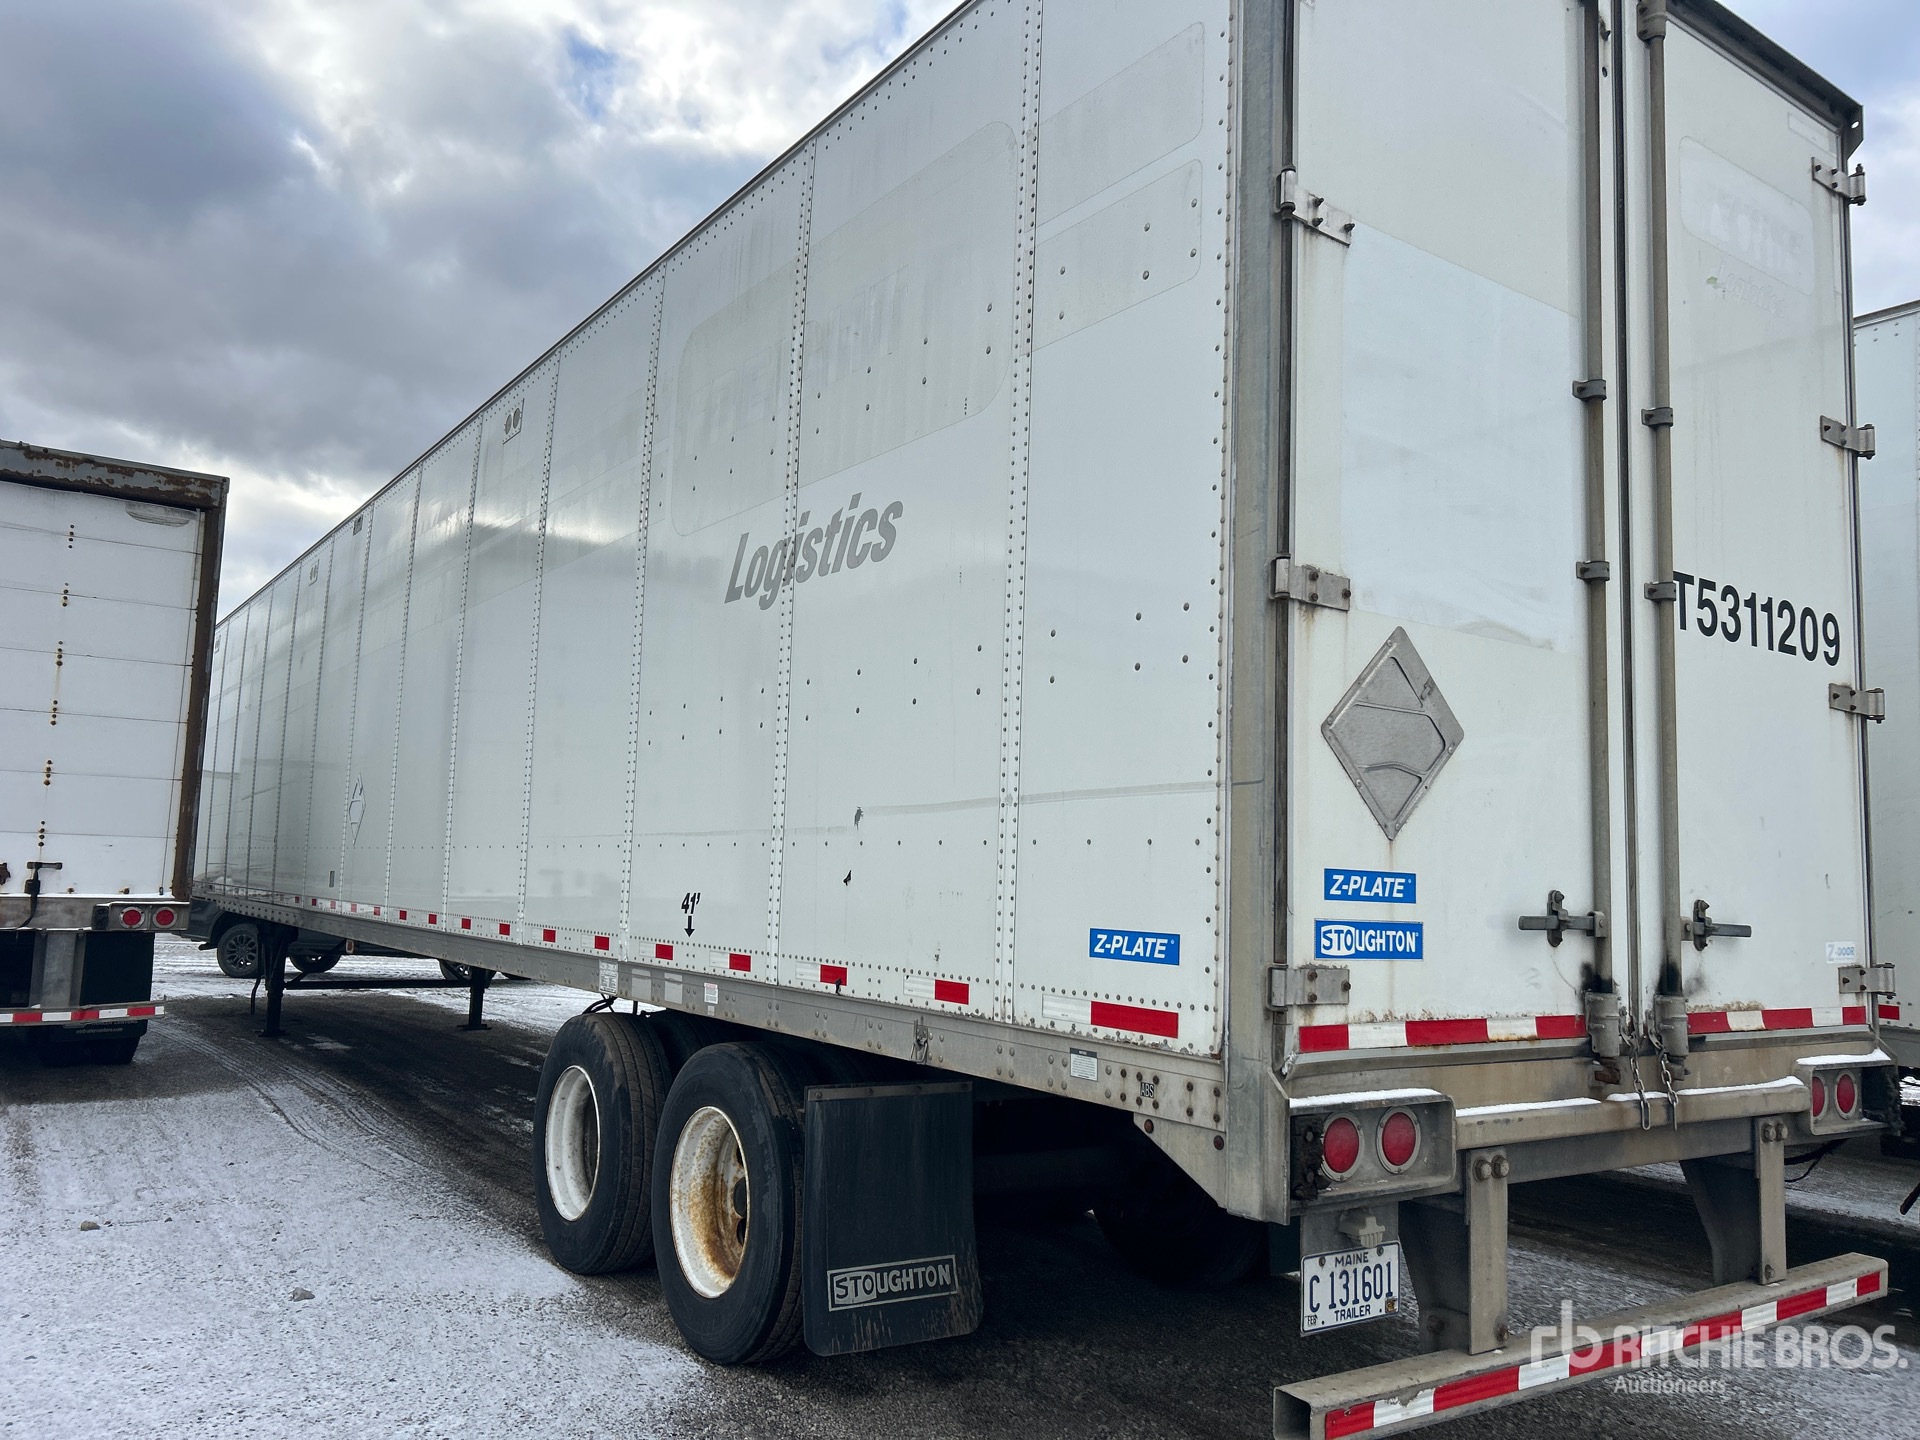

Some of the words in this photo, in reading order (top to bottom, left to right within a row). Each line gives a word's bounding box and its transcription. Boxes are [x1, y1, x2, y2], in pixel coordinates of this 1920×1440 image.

[724, 492, 903, 610] Logistics
[1673, 571, 1840, 666] T5311209
[1141, 1083, 1154, 1098] ABS
[1335, 1252, 1369, 1267] MAINE
[835, 1264, 951, 1300] STOUGHTON
[1334, 1304, 1371, 1321] TRAILER
